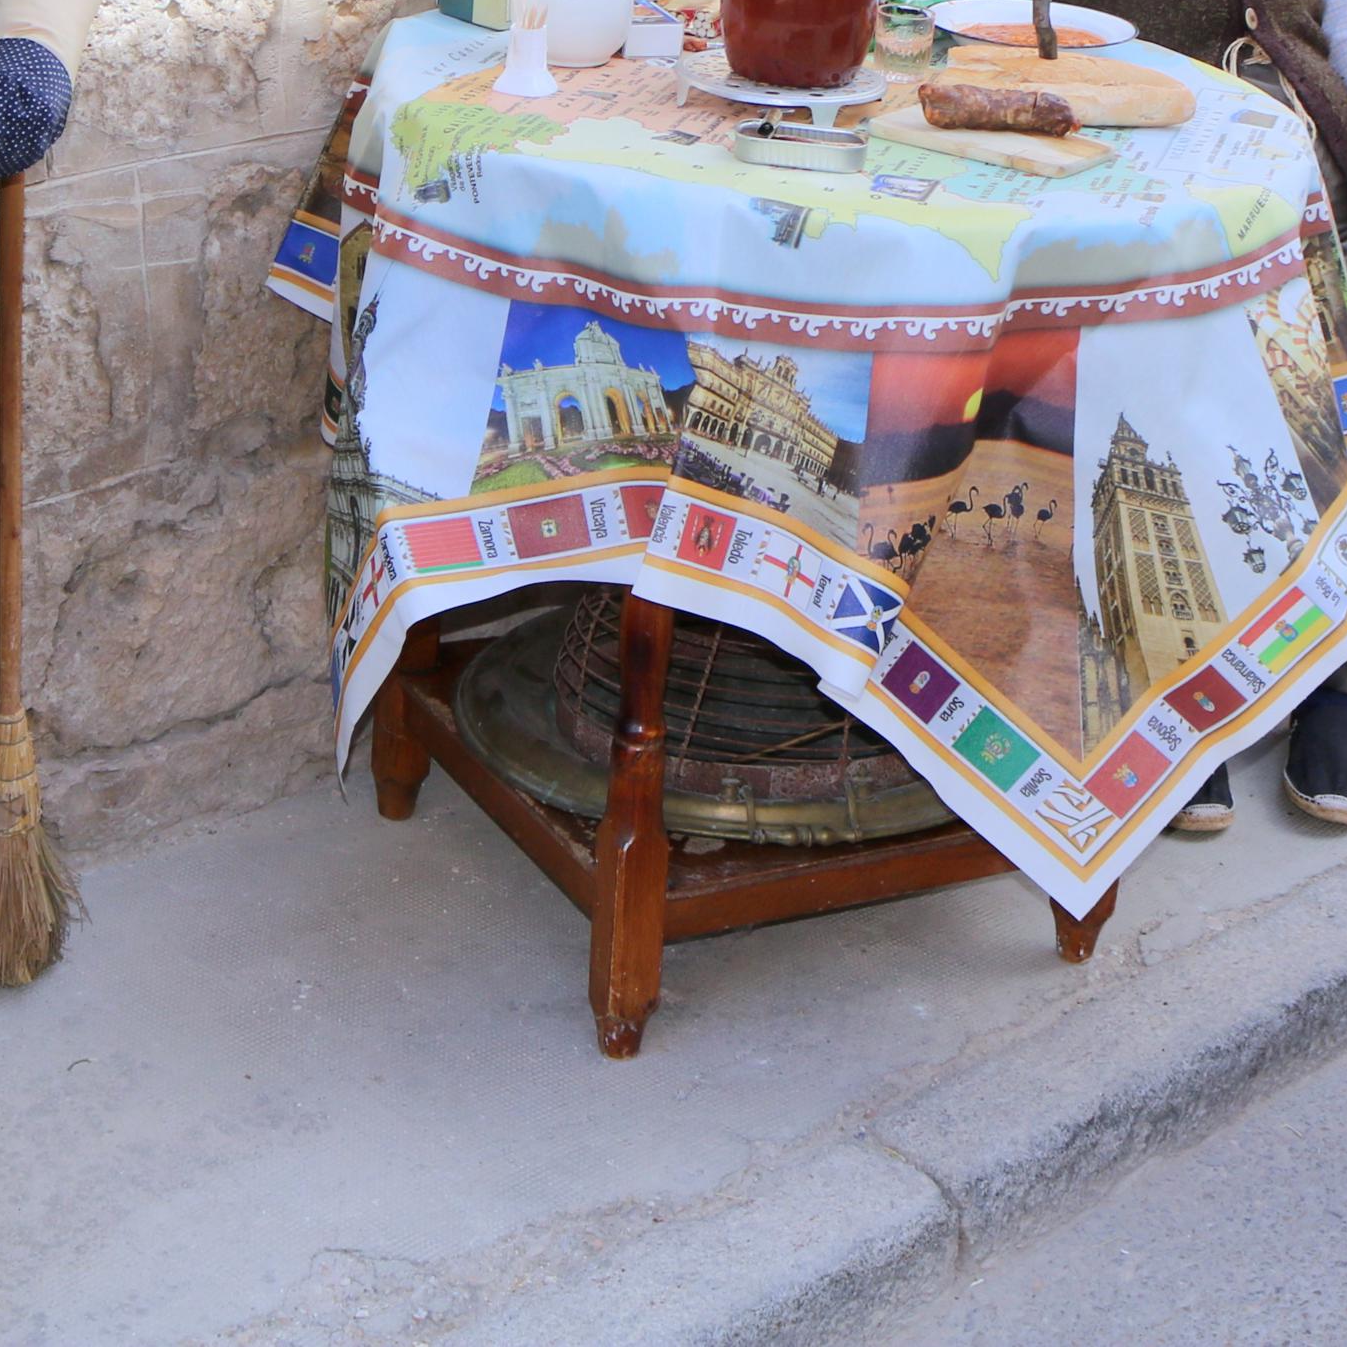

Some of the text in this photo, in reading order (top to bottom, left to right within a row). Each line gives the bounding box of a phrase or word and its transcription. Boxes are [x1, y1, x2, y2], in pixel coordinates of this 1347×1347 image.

[590, 497, 609, 540] Vizcaya
[651, 502, 670, 545] Valencia
[477, 518, 500, 559] Zamora
[727, 528, 754, 565] Toledo
[812, 572, 833, 610] Teruel
[1220, 648, 1267, 694] Salamanca
[939, 695, 964, 723] Soria
[1146, 715, 1183, 752] Segovia
[1019, 766, 1052, 798] Sevilla
